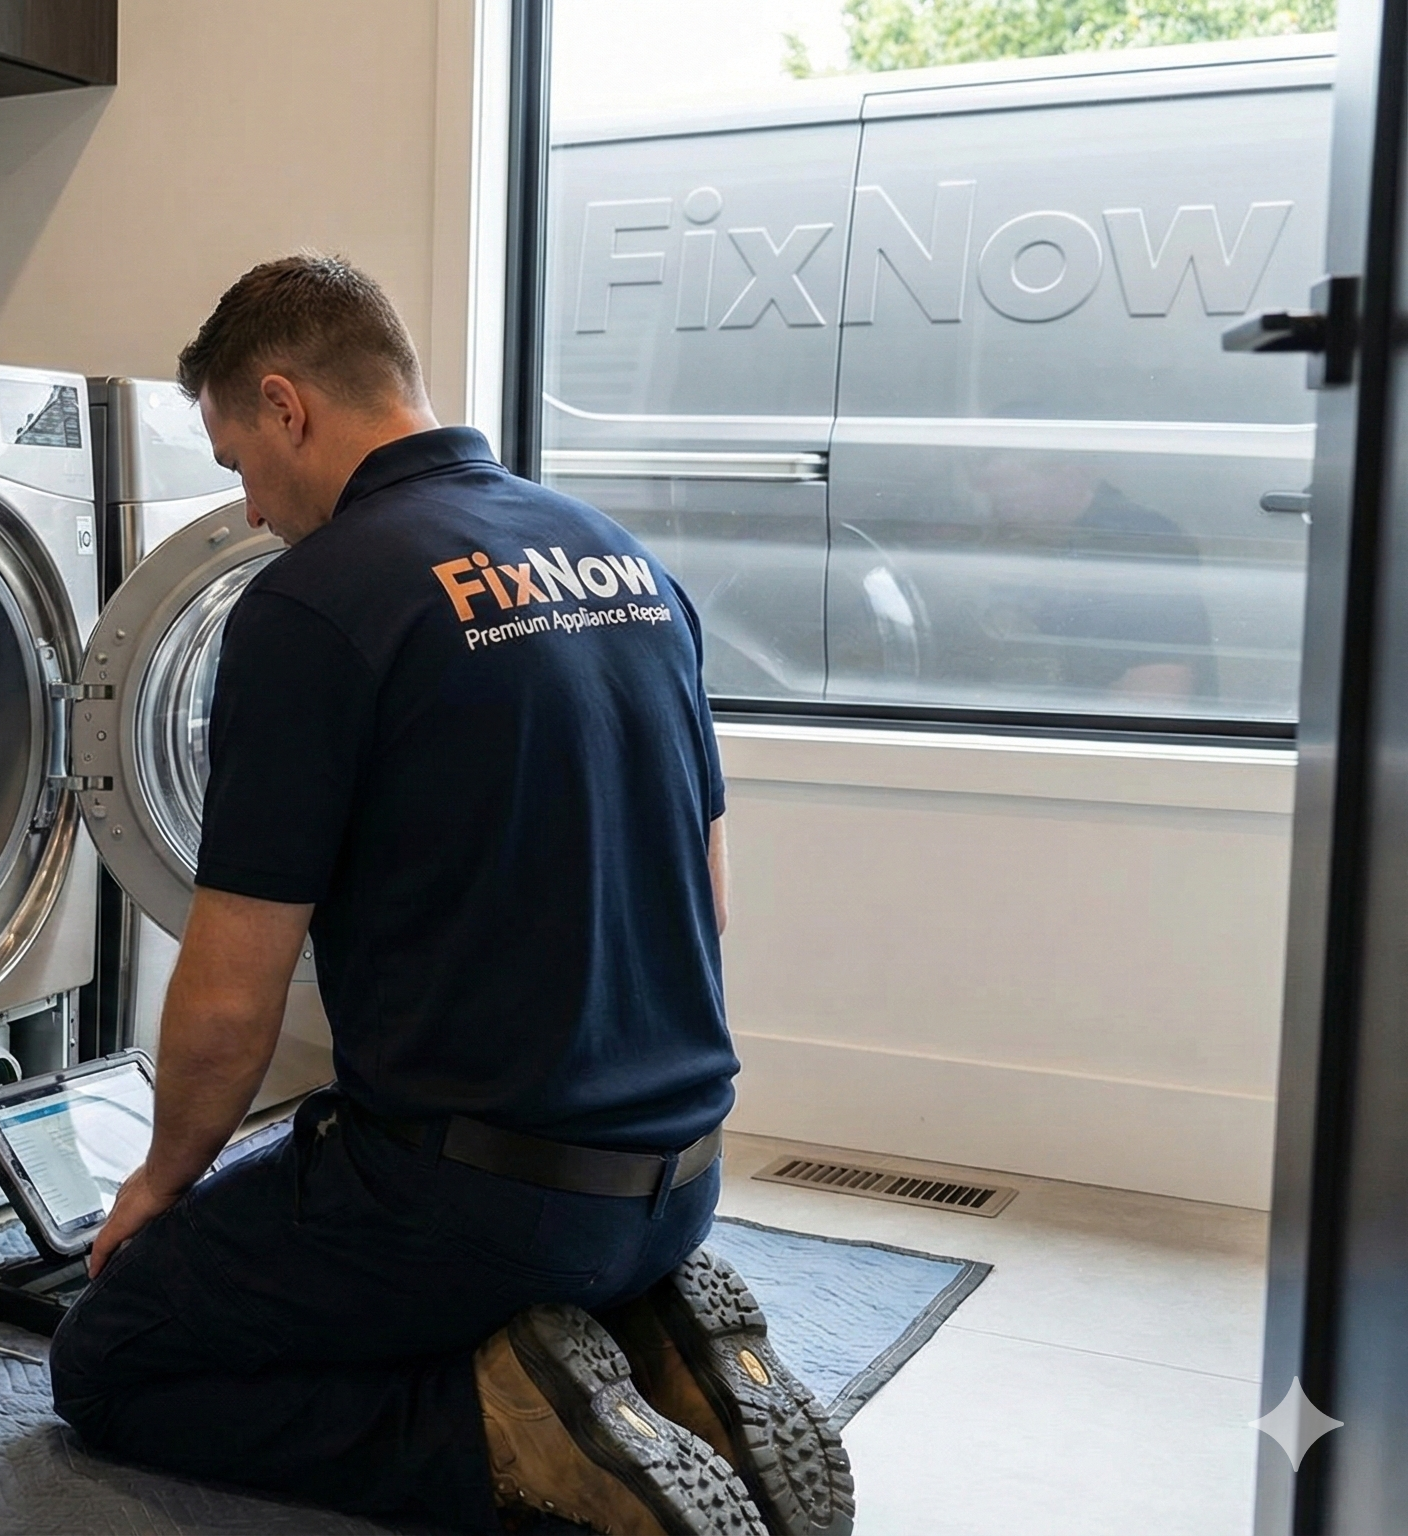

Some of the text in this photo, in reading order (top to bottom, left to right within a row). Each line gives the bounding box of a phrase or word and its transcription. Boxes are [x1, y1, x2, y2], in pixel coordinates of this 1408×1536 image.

[574, 180, 1295, 334] FixNow
[431, 546, 659, 622] FixNow
[465, 616, 551, 650] Premium
[552, 606, 627, 634] Appliance
